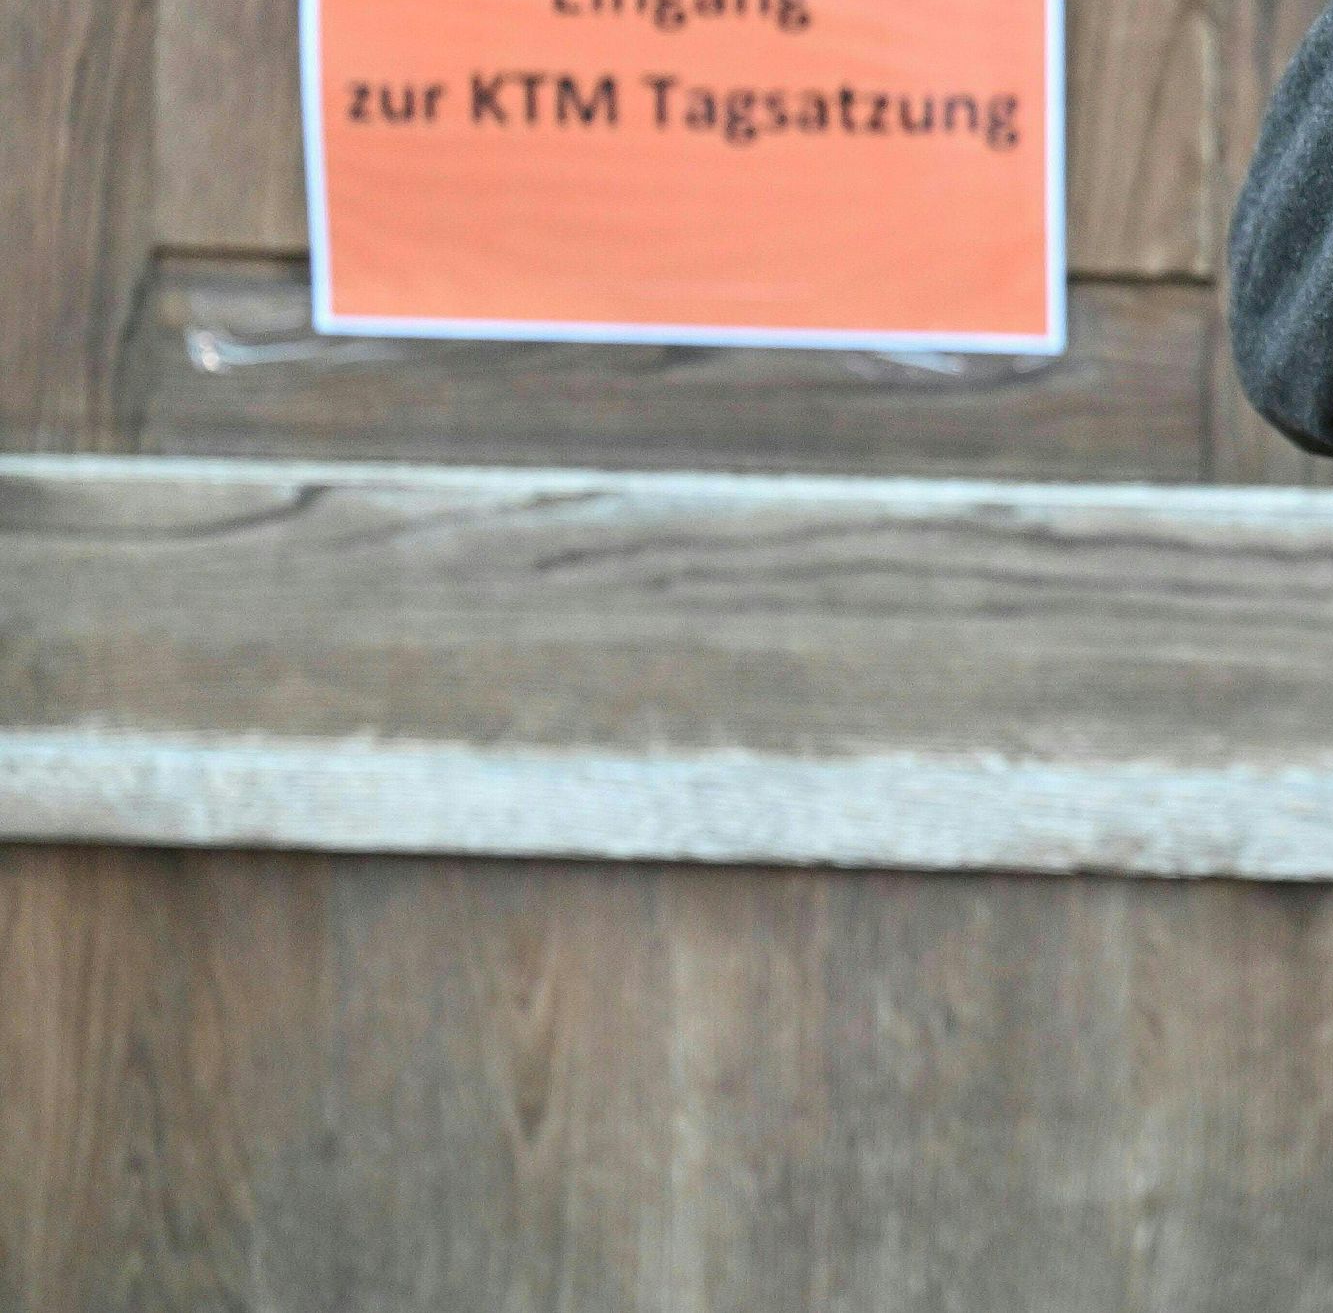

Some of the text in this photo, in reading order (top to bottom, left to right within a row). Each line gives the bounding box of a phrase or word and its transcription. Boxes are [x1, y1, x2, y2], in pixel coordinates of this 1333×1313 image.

[347, 71, 1022, 149] zur KTM Tagsatzung
